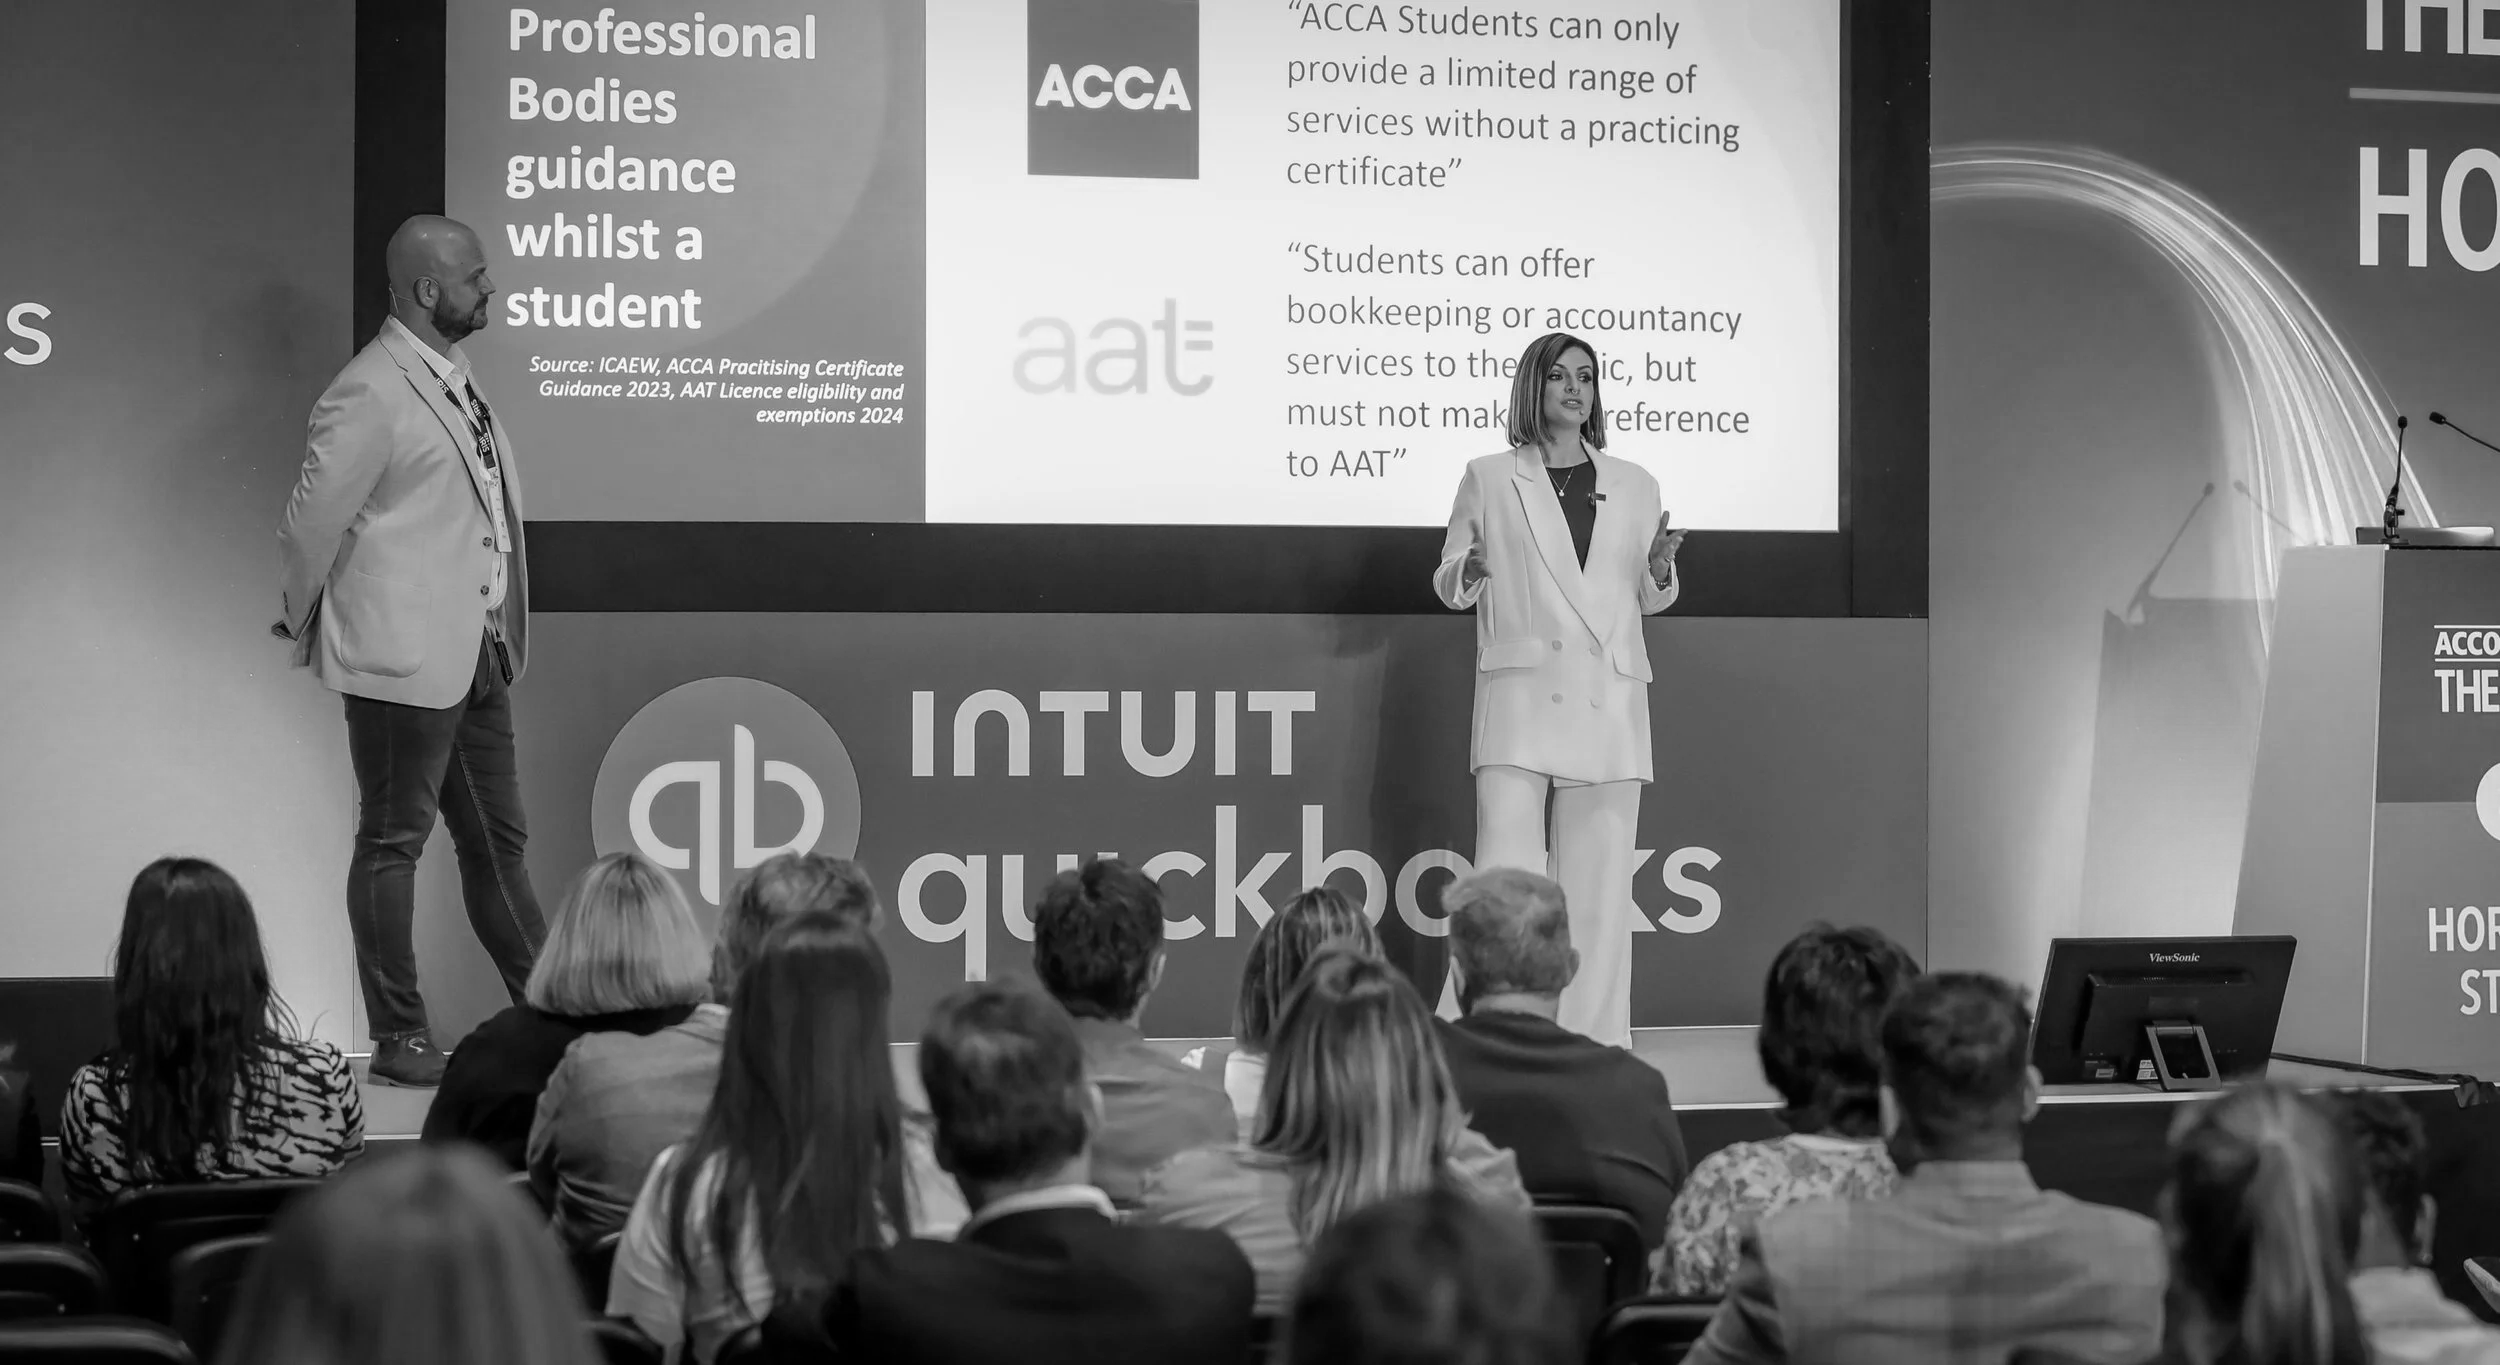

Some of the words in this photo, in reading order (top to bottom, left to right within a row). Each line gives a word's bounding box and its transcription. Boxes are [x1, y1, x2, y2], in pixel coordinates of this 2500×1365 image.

[510, 7, 816, 60] Professional
[1288, 0, 1388, 33] “ACCA
[1398, 5, 1538, 39] Students
[1549, 17, 1602, 40] can
[1614, 12, 1680, 50] only
[1034, 63, 1192, 112] ACCA
[1288, 54, 1408, 89] provide
[1419, 64, 1435, 86] a
[1448, 56, 1556, 90] limited
[1569, 69, 1655, 99] range
[1666, 63, 1698, 94] of
[509, 76, 677, 125] Bodies
[1287, 106, 1414, 137] services
[1425, 108, 1549, 140] without
[1560, 119, 1576, 141] a
[1589, 115, 1740, 153] practicing
[505, 144, 736, 200] guidance
[1287, 155, 1463, 188] certificate”
[2359, 146, 2500, 272] HO
[506, 212, 660, 260] whilst
[675, 226, 703, 261] a
[1288, 242, 1444, 277] “Students
[1455, 254, 1508, 277] can
[1520, 247, 1595, 279] offer
[506, 282, 702, 330] student
[1288, 294, 1492, 335] bookkeeping
[1502, 307, 1536, 329] or
[1544, 305, 1742, 339] accountancy
[529, 355, 595, 374] Source:
[599, 356, 661, 377] ICAEW,
[665, 357, 714, 376] ACCA
[718, 358, 811, 380] Pracitising
[815, 359, 905, 380] Certificate
[1011, 297, 1216, 397] aat
[1287, 347, 1413, 378] services
[1424, 351, 1456, 378] to
[1466, 348, 1517, 379] the
[1646, 351, 1697, 383] but
[539, 379, 623, 398] Guidance
[626, 380, 675, 401] 2023,
[679, 381, 717, 399] AAT
[719, 382, 784, 400] Licence
[786, 382, 867, 404] eligibility
[870, 383, 905, 401] and
[756, 406, 856, 428] exemptions
[859, 406, 905, 425] 2024
[1288, 400, 1366, 428] must
[1378, 401, 1430, 428] not
[1442, 399, 1509, 429] mak
[1604, 401, 1750, 434] reference
[1286, 450, 1319, 478] to
[1329, 447, 1407, 478] AAT”
[2434, 631, 2500, 656] ACCO
[2434, 669, 2500, 713] THE
[912, 689, 1316, 778] INTUIT
[897, 804, 1722, 982] quckbos
[2148, 952, 2201, 963] ViewSonic
[2460, 968, 2500, 1016] ST
